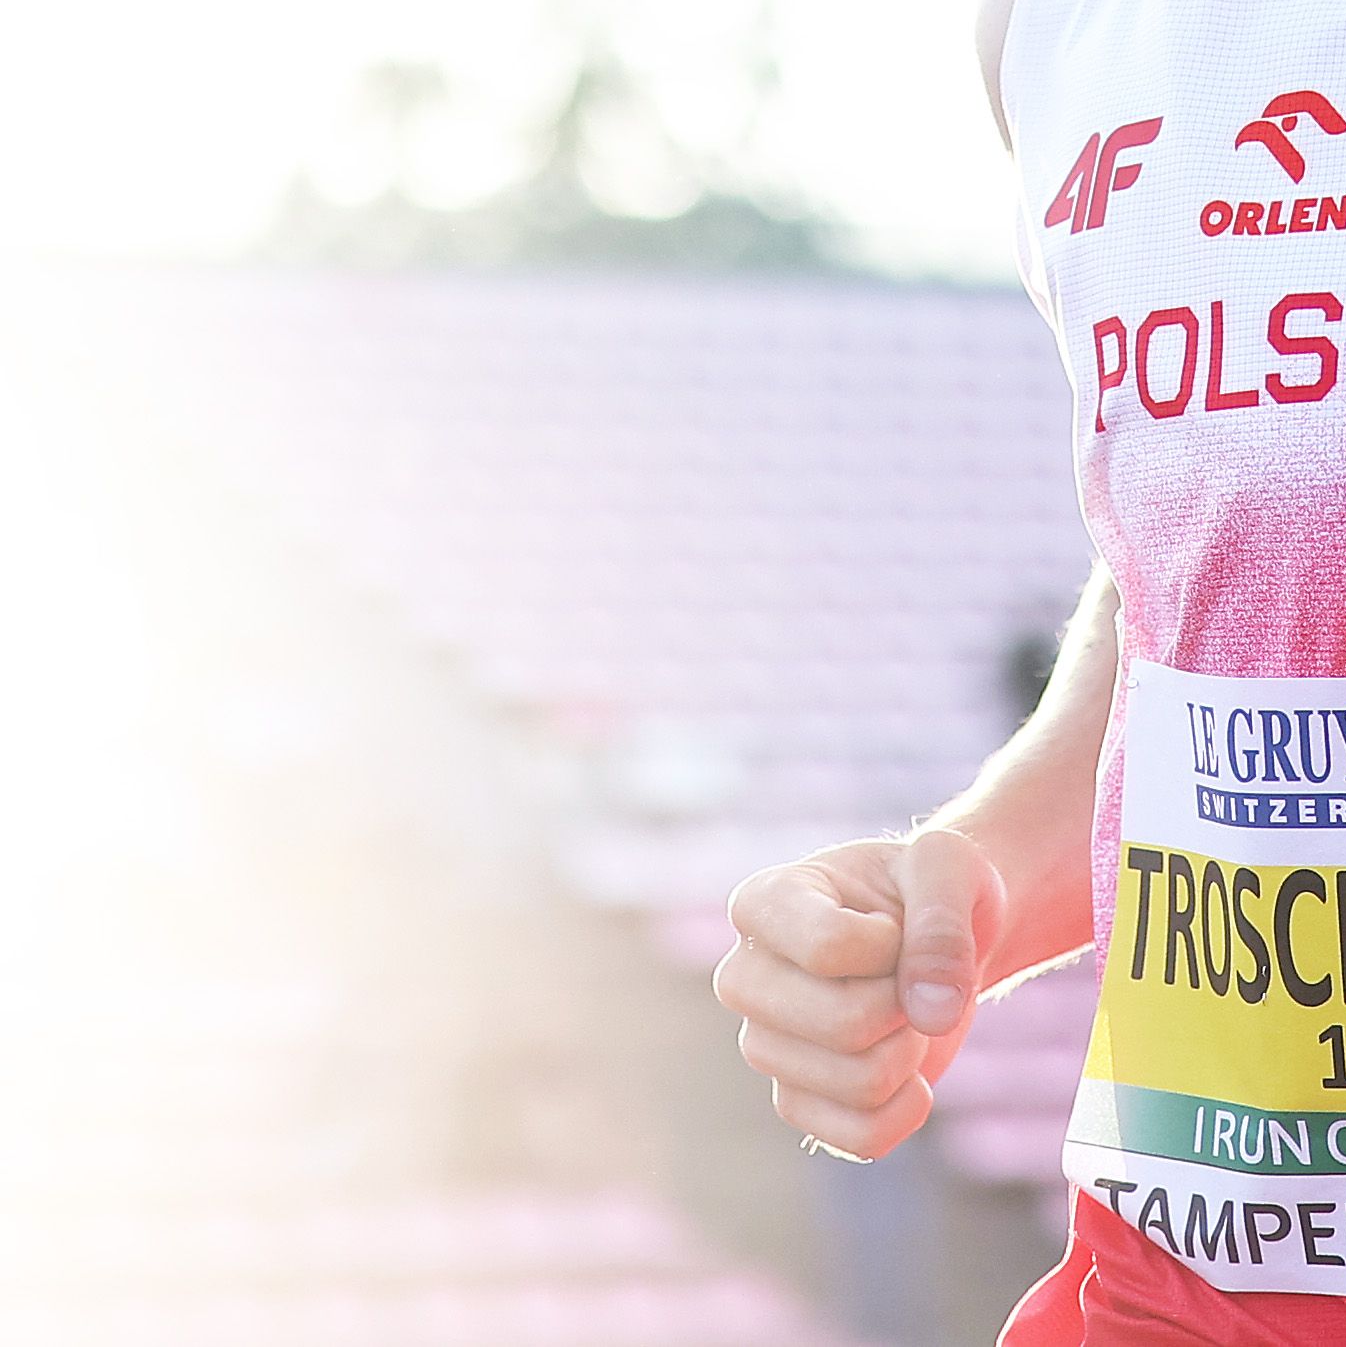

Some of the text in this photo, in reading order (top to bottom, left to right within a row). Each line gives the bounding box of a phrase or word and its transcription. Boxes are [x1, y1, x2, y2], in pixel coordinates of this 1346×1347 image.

[1186, 701, 1219, 779] LE
[1193, 1105, 1205, 1154] I
[1212, 1108, 1313, 1167] RUN
